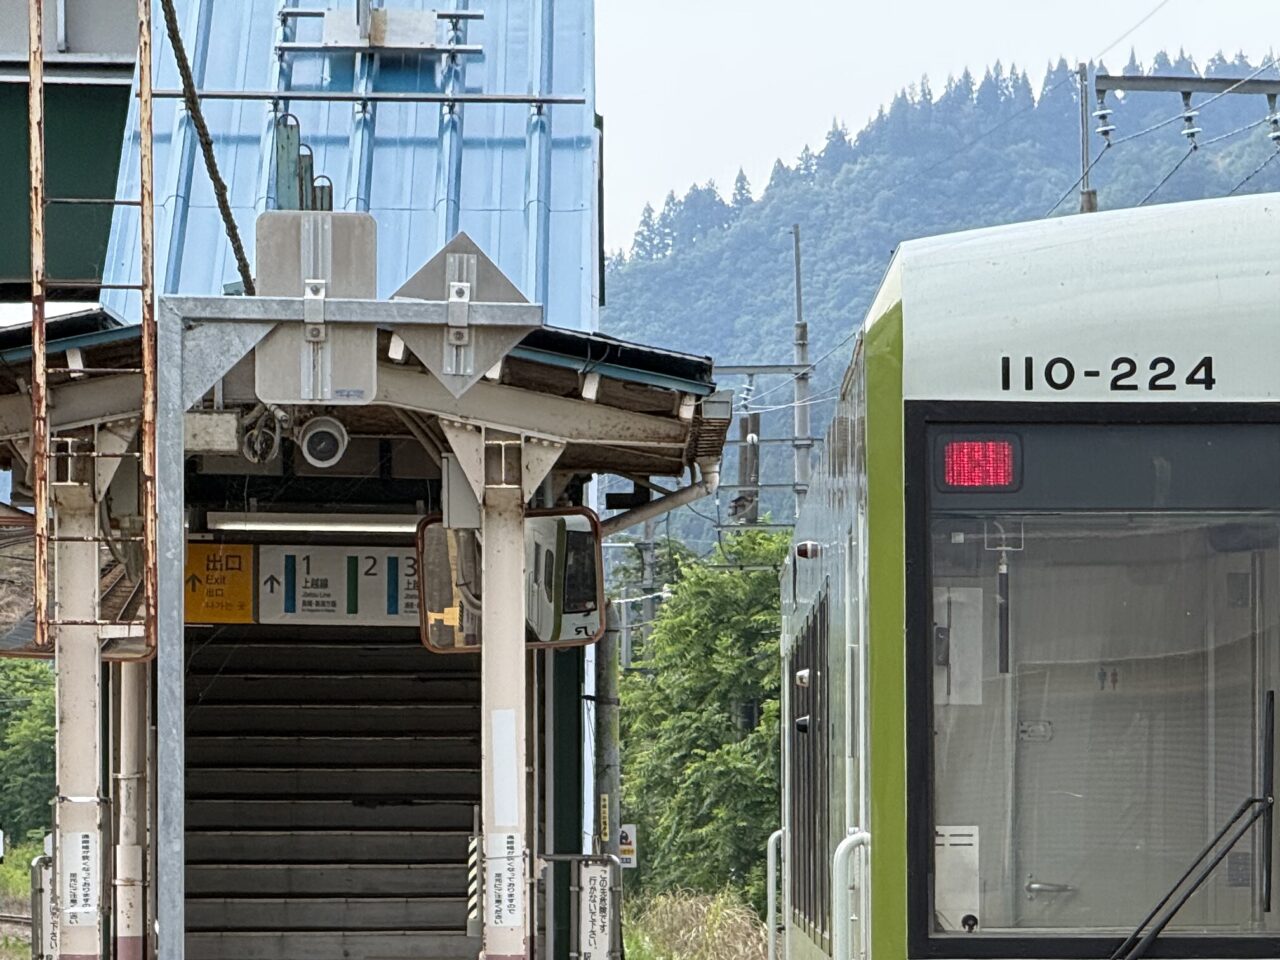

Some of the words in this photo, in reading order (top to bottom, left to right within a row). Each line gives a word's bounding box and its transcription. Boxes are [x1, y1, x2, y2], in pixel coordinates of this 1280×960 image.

[1001, 356, 1216, 390] 110-224
[206, 554, 242, 571] 出口
[302, 555, 311, 575] 1
[364, 556, 378, 576] 2
[404, 557, 418, 577] 3
[206, 574, 225, 585] Exit
